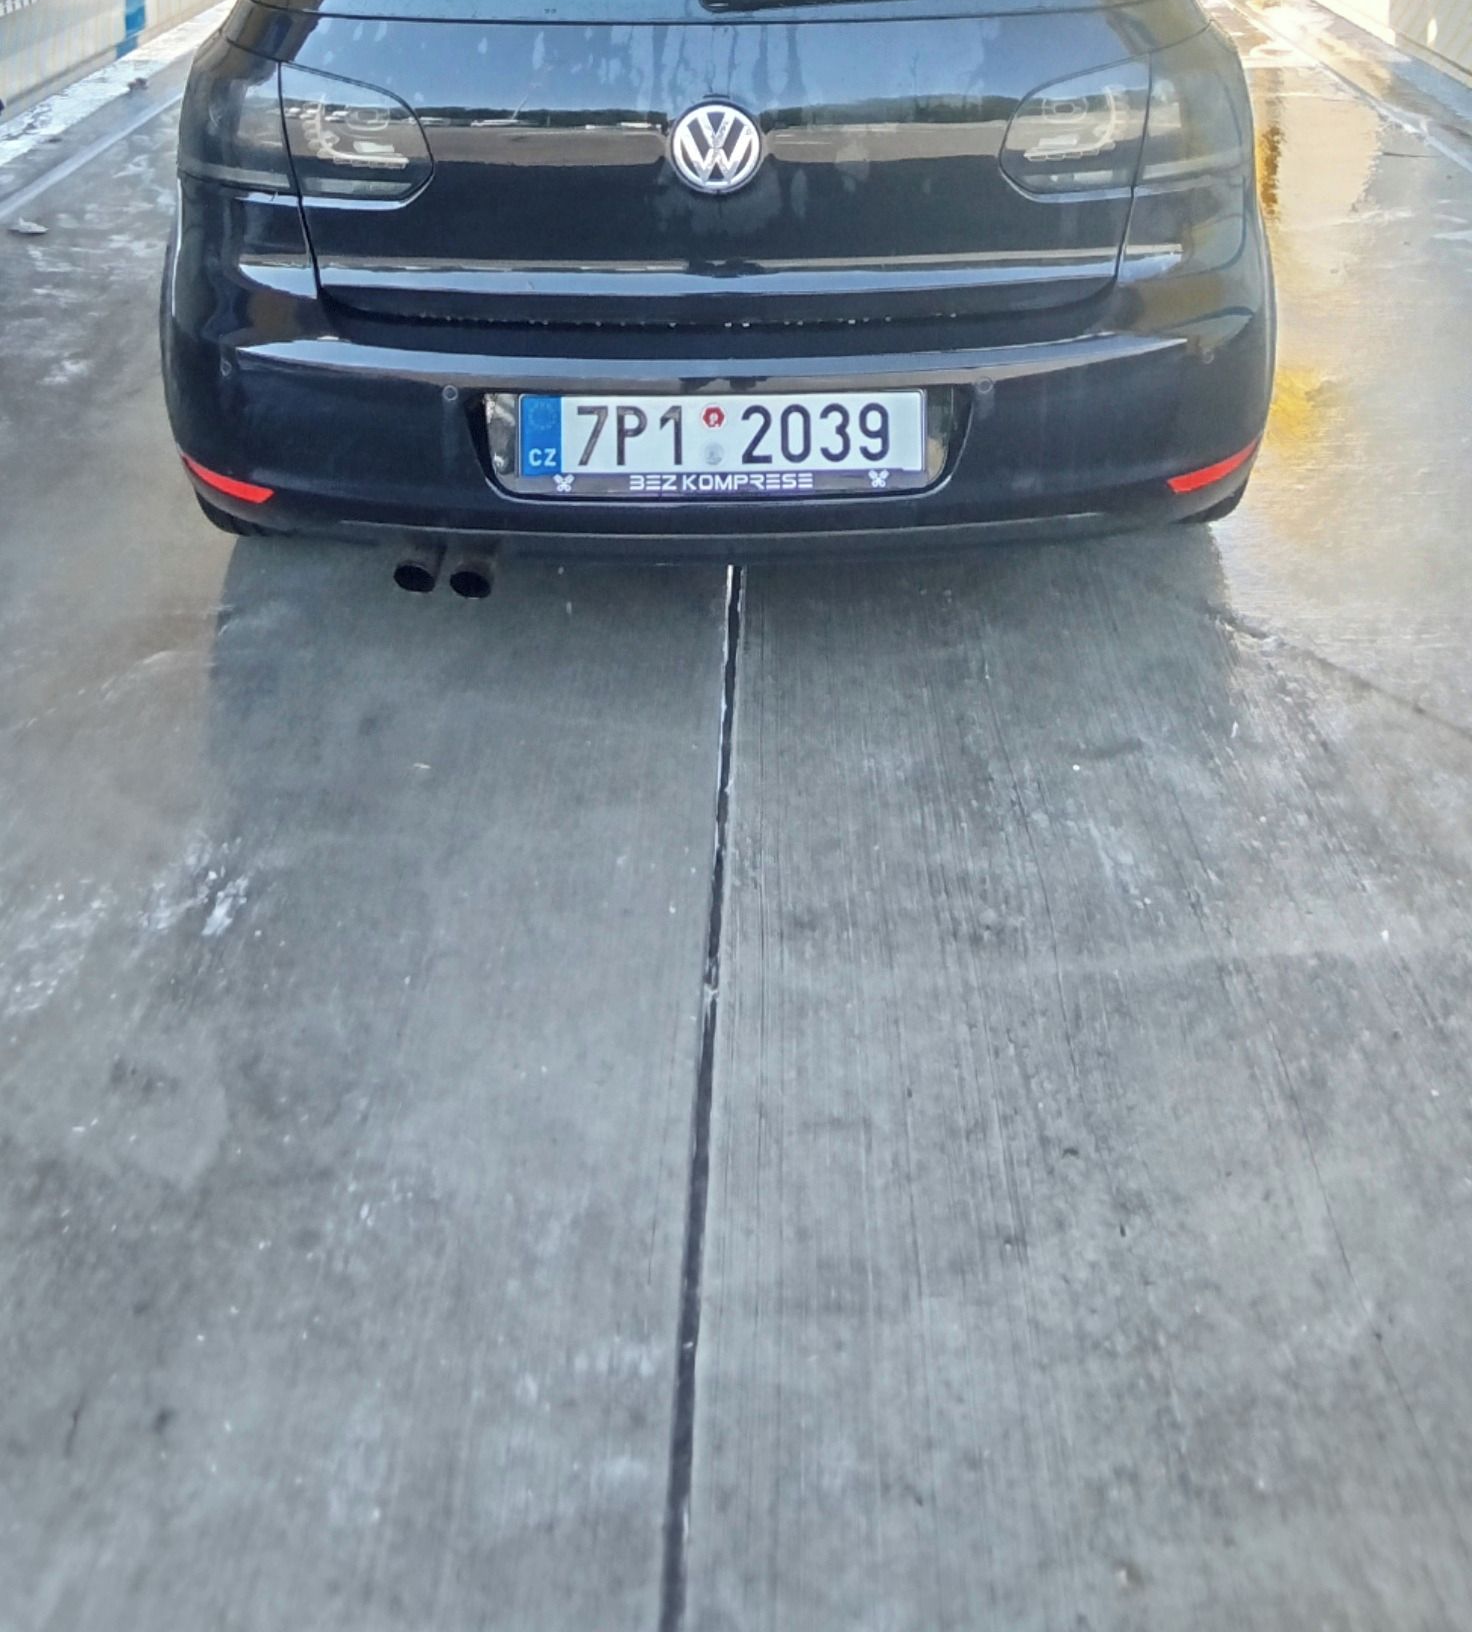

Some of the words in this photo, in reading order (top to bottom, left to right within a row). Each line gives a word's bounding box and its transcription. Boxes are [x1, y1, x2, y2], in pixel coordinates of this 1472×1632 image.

[576, 405, 684, 466] 7P1
[740, 402, 890, 465] 2039
[528, 448, 557, 467] CZ
[629, 474, 677, 491] BEZ
[682, 472, 813, 490] KOMPRESE
